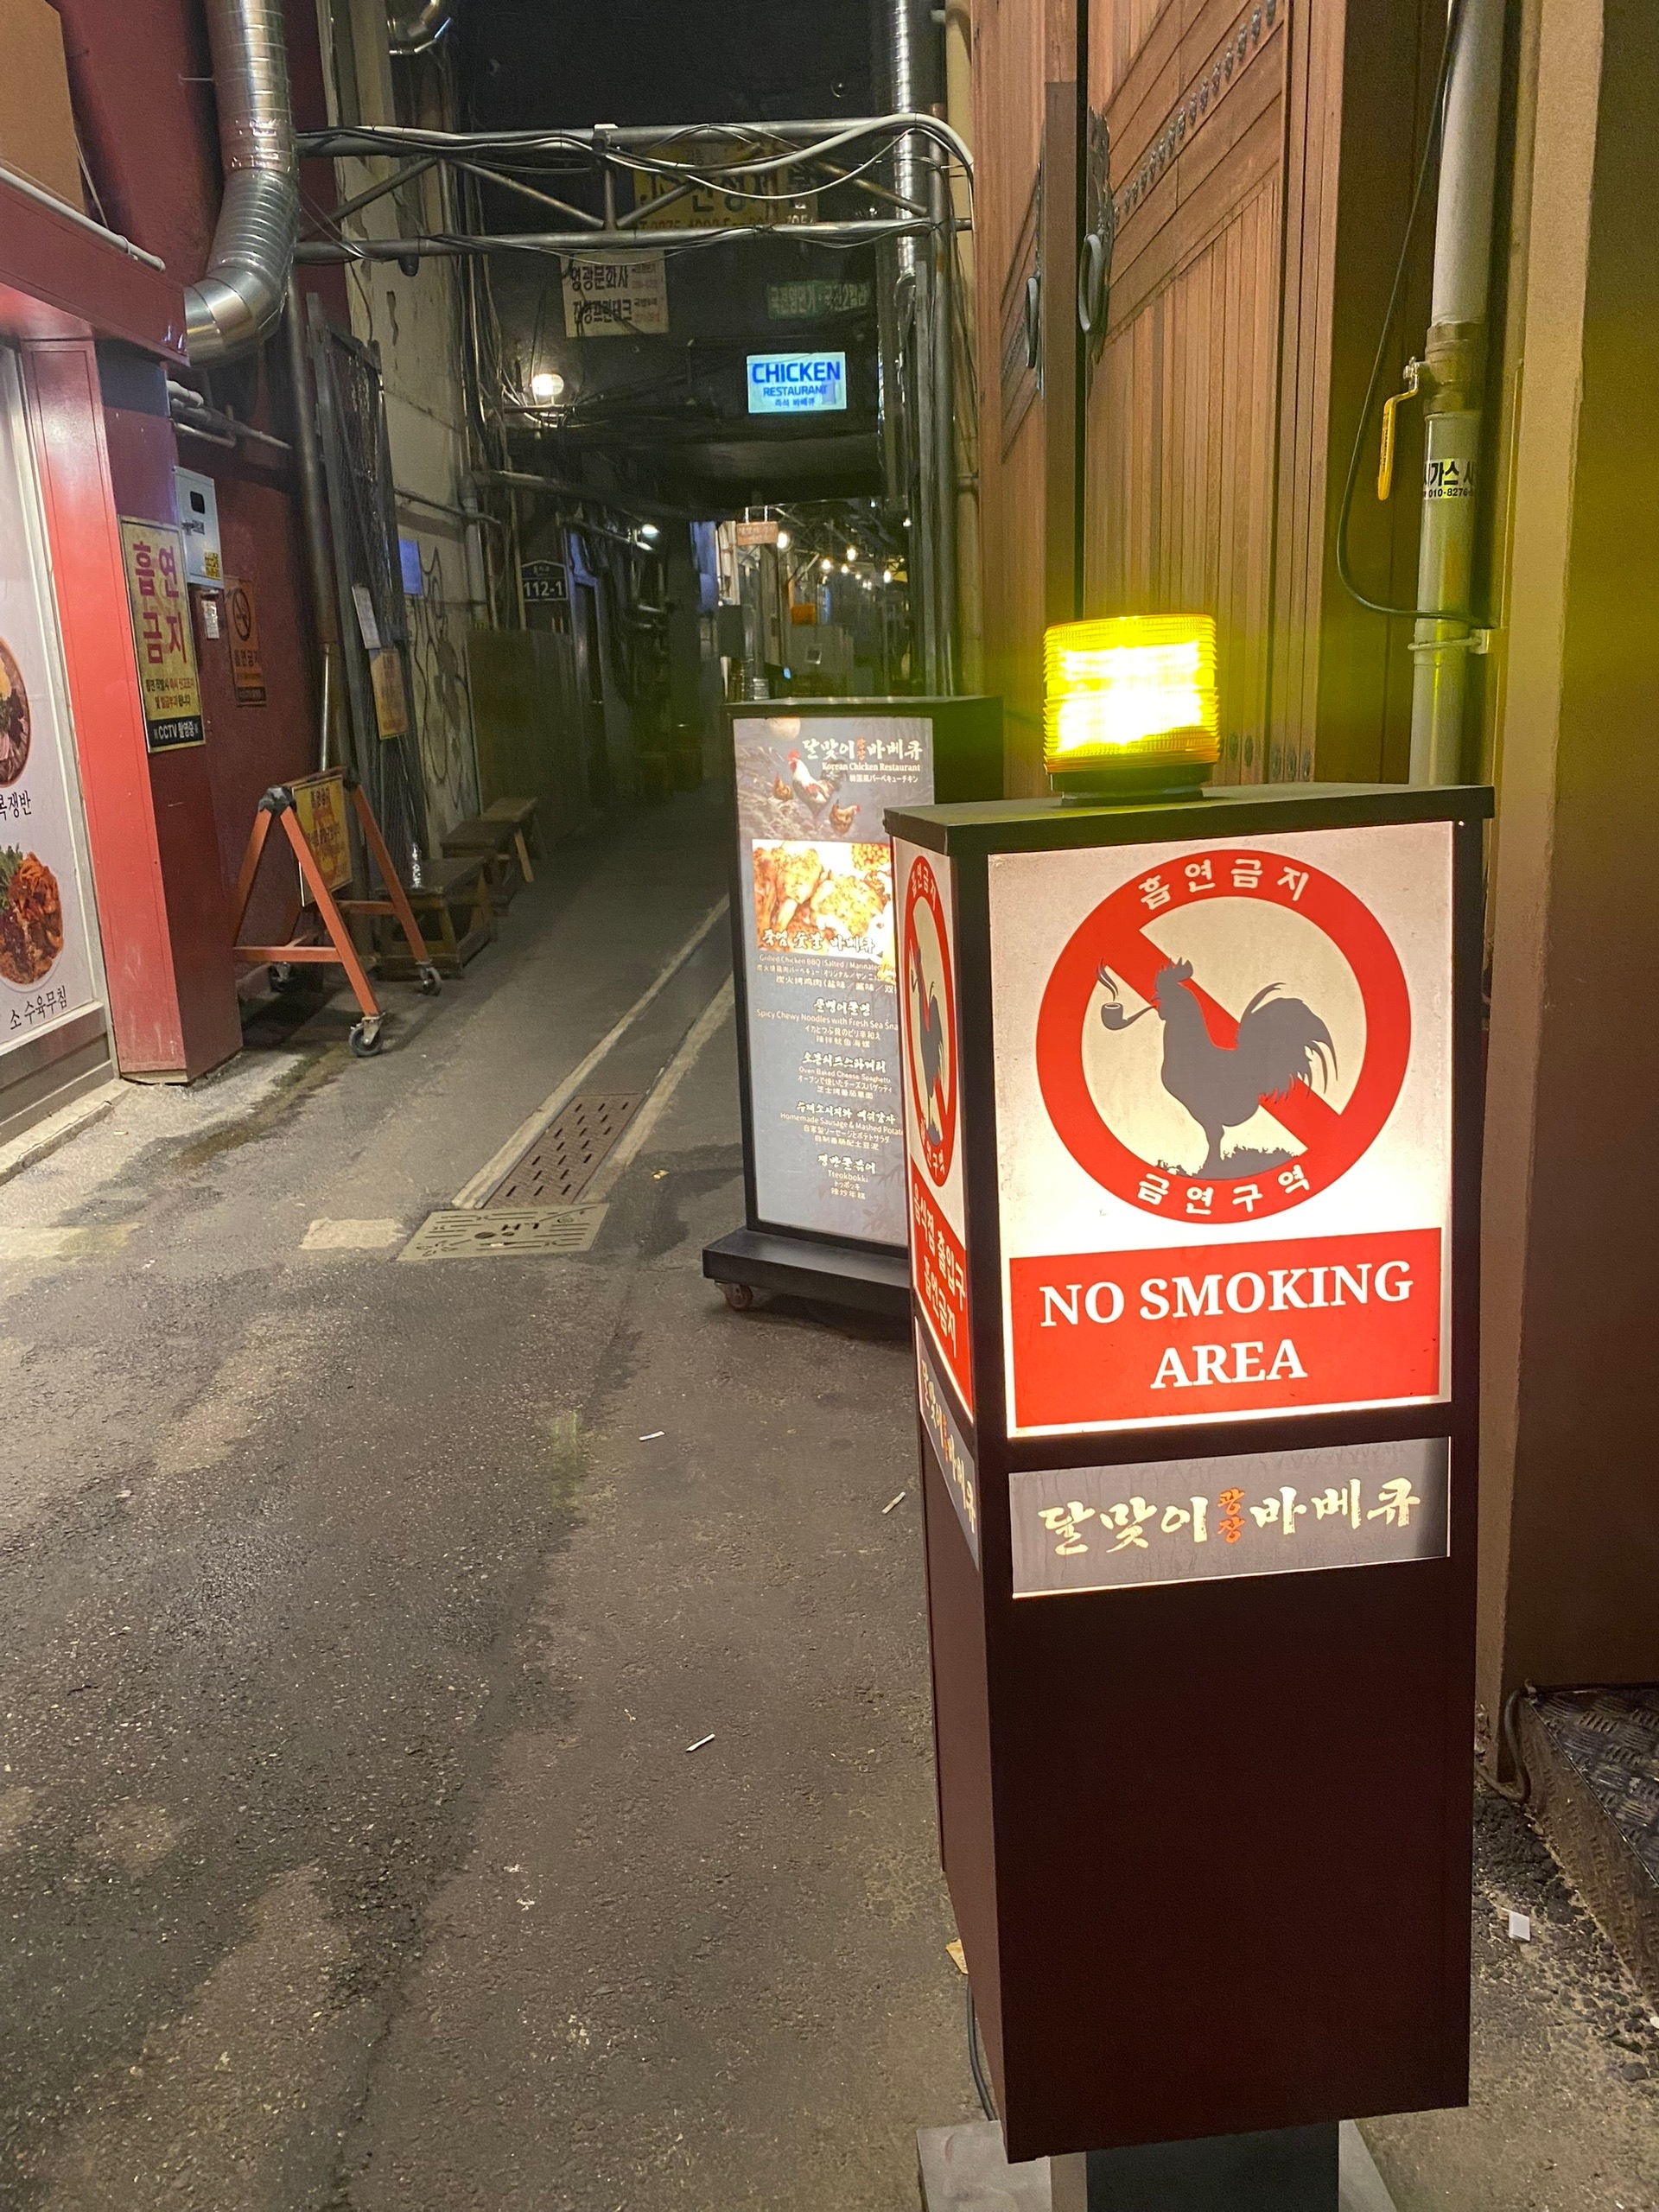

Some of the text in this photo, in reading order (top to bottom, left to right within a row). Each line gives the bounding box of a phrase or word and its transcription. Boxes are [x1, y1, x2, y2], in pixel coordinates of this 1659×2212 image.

[752, 361, 841, 384] CHICKEN
[763, 385, 828, 397] RESTAURANT
[132, 540, 180, 599] 흡연
[524, 581, 563, 597] 112-1
[143, 610, 188, 664] 금지
[158, 723, 178, 740] CCTV
[802, 738, 855, 760] 달맞이
[867, 738, 924, 761] 바베큐
[822, 762, 921, 772] Korean Chicken Restaurant
[911, 861, 938, 910] 흡연금지
[1139, 857, 1311, 910] 흡연금지
[830, 934, 875, 954] 바베큐
[760, 954, 780, 963] Grilled
[781, 956, 806, 965] Chicken
[806, 958, 821, 967] BBQ
[756, 1008, 899, 1031] Spicy Chewy Noodles with Fresh Sea Sna
[798, 1065, 892, 1084] Oven Baked Cheese Spaghetti
[780, 1111, 819, 1124] Homemade
[820, 1116, 849, 1128] Sausage
[855, 1122, 883, 1134] Mashed
[828, 1169, 869, 1184] Tteokbokki
[1138, 1164, 1311, 1216] 금연구역
[914, 1183, 966, 1313] 음식점 출입구
[1039, 1260, 1414, 1327] NO SMOKING
[924, 1255, 957, 1358] 흡연금지
[1150, 1338, 1308, 1389] AREA
[1037, 1477, 1422, 1556] 달맞이 광장 바베큐
